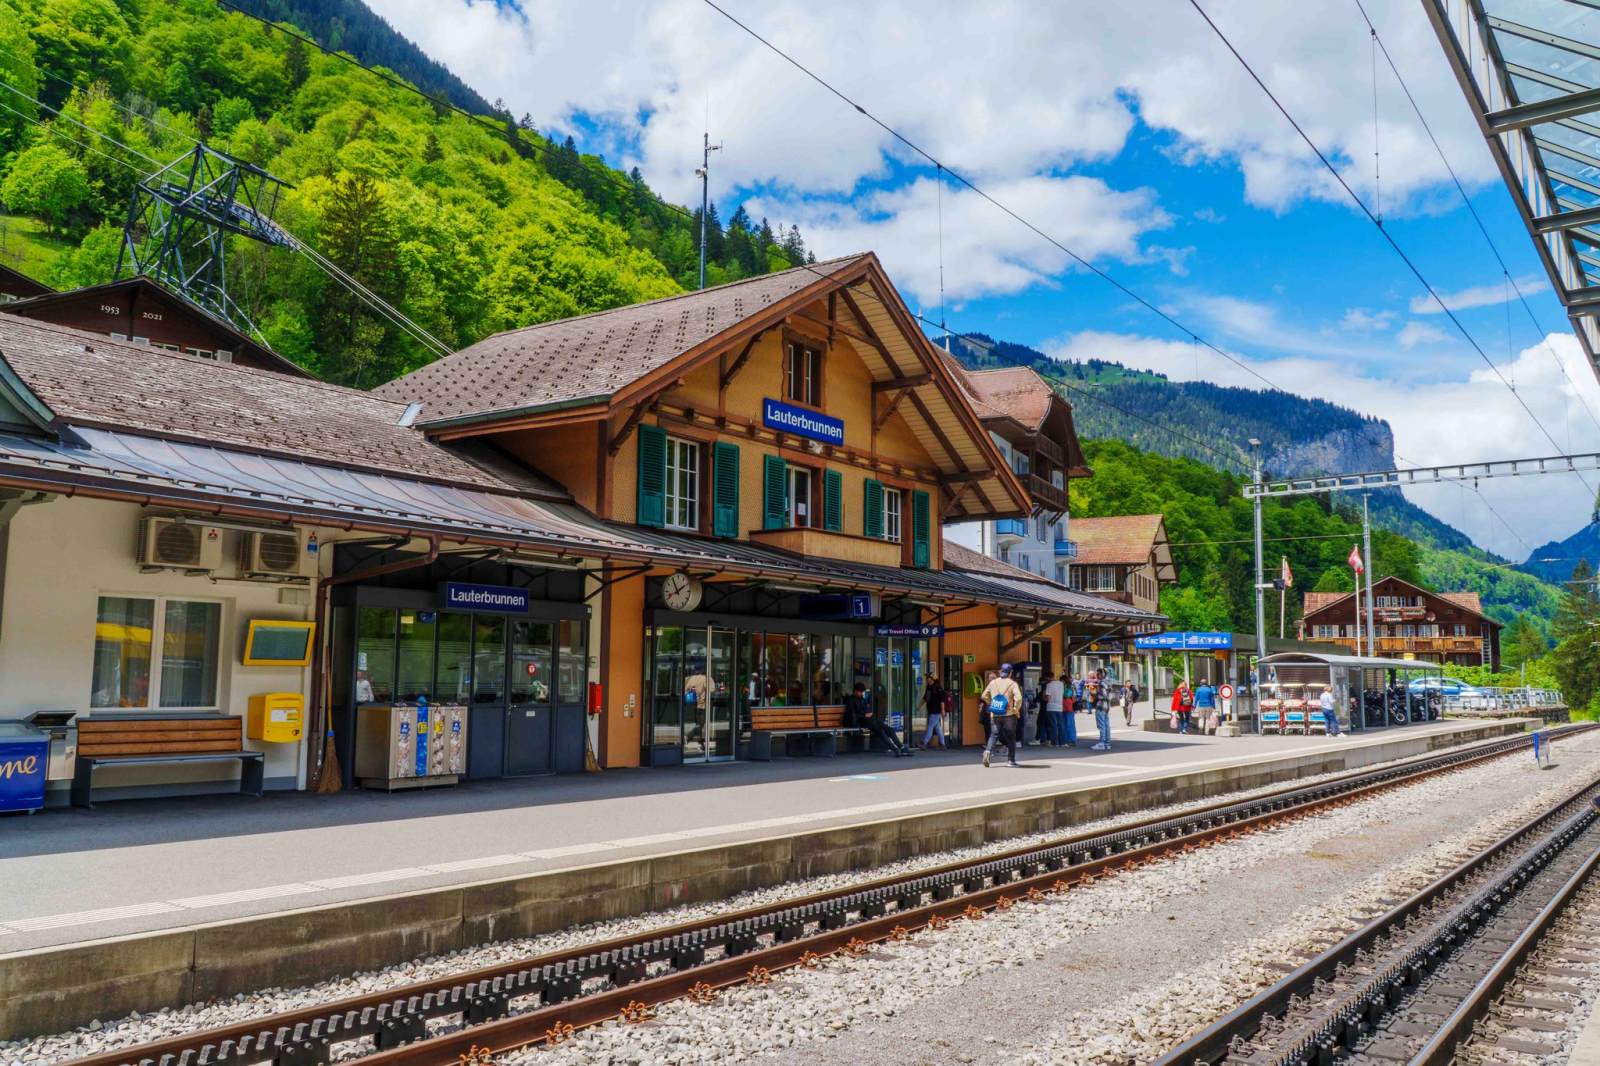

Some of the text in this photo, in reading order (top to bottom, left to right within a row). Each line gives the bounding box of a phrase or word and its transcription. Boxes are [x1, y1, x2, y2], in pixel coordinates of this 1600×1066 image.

[100, 305, 120, 315] 1953
[142, 312, 162, 321] 2021
[767, 404, 842, 438] Lauterbrunnen
[451, 588, 525, 606] Lauterbrunnen
[859, 601, 864, 613] 1
